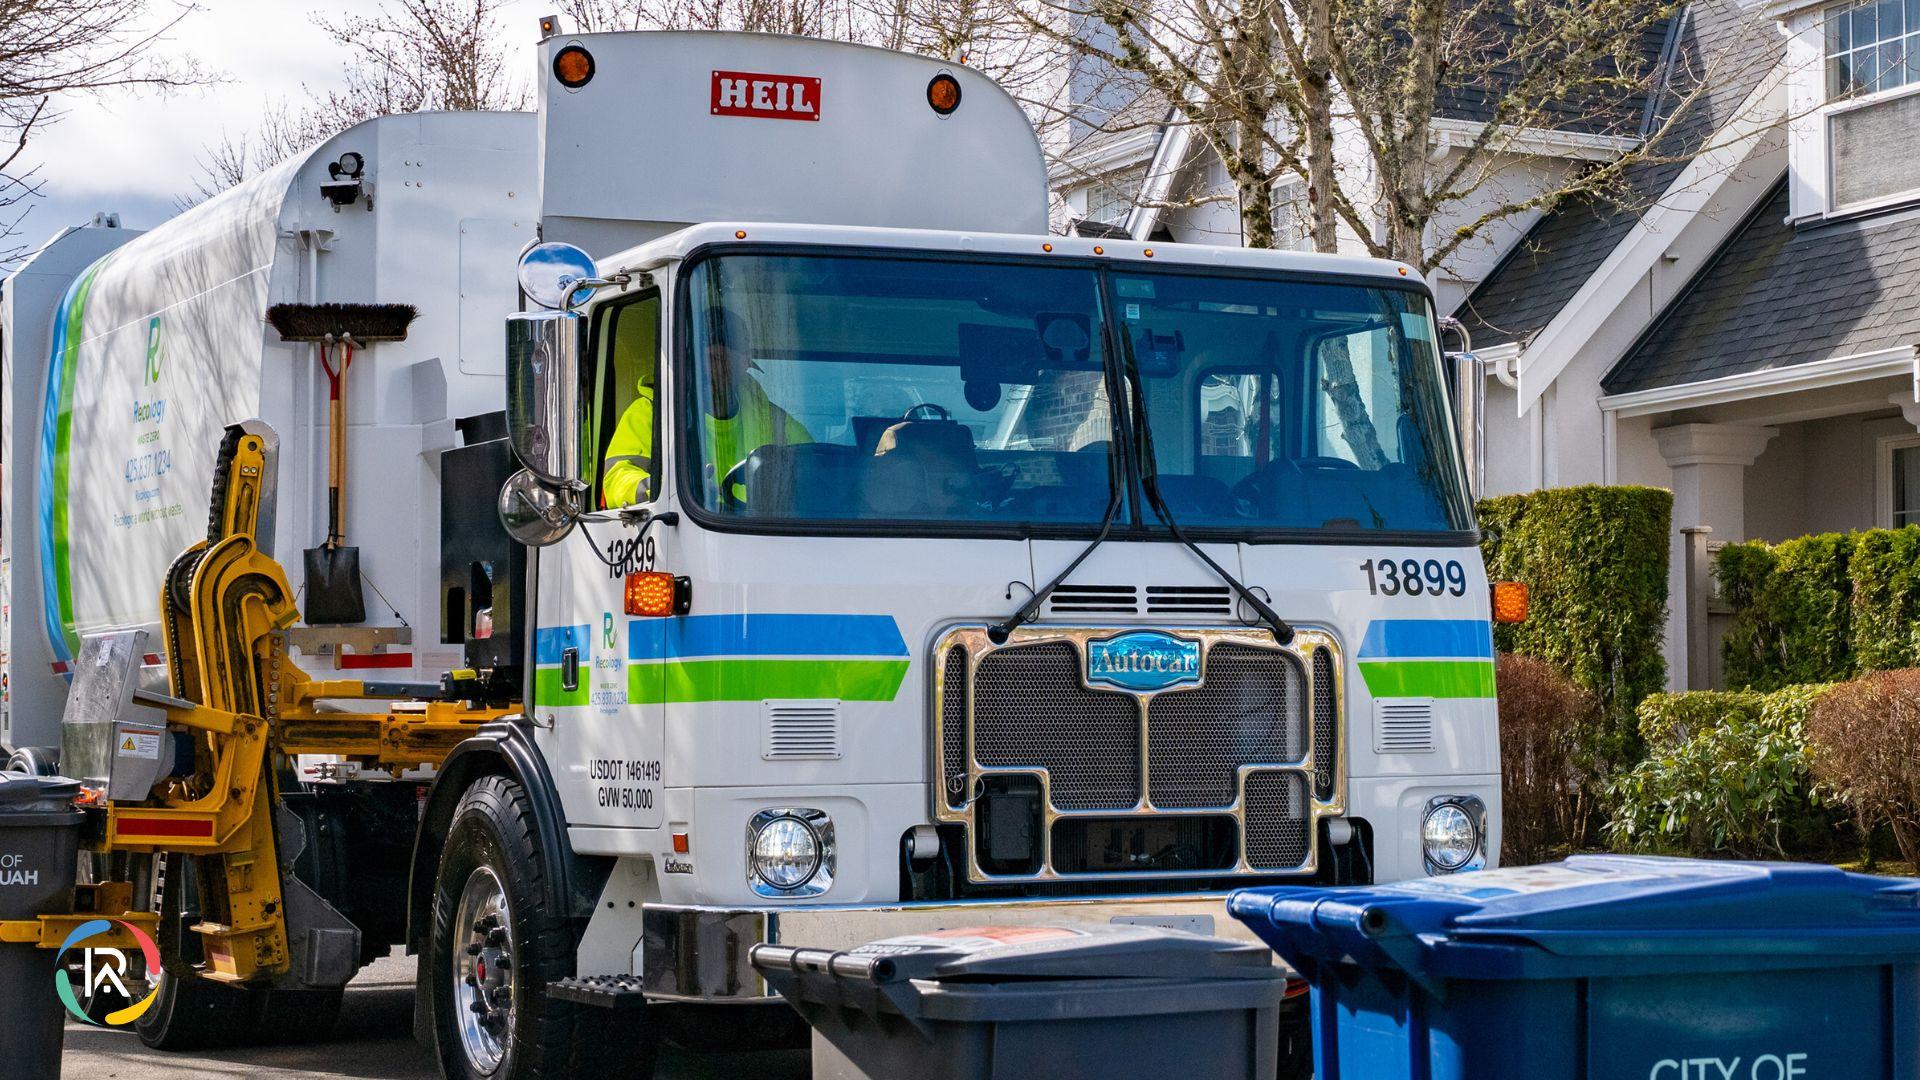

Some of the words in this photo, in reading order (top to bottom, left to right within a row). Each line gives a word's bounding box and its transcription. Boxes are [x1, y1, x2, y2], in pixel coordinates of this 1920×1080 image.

[719, 78, 814, 112] HEIL
[133, 395, 166, 425] Recology
[607, 536, 655, 579] 13899
[1359, 558, 1467, 597] 13899
[595, 655, 622, 672] Recology
[1094, 647, 1196, 673] Autocar
[590, 759, 623, 780] USDOT
[625, 760, 661, 781] 1461419
[598, 787, 620, 808] GVW
[622, 788, 653, 812] 50,000
[1, 854, 23, 867] OF
[1649, 1056, 1741, 1080] CITY
[1751, 1052, 1808, 1080] OF
